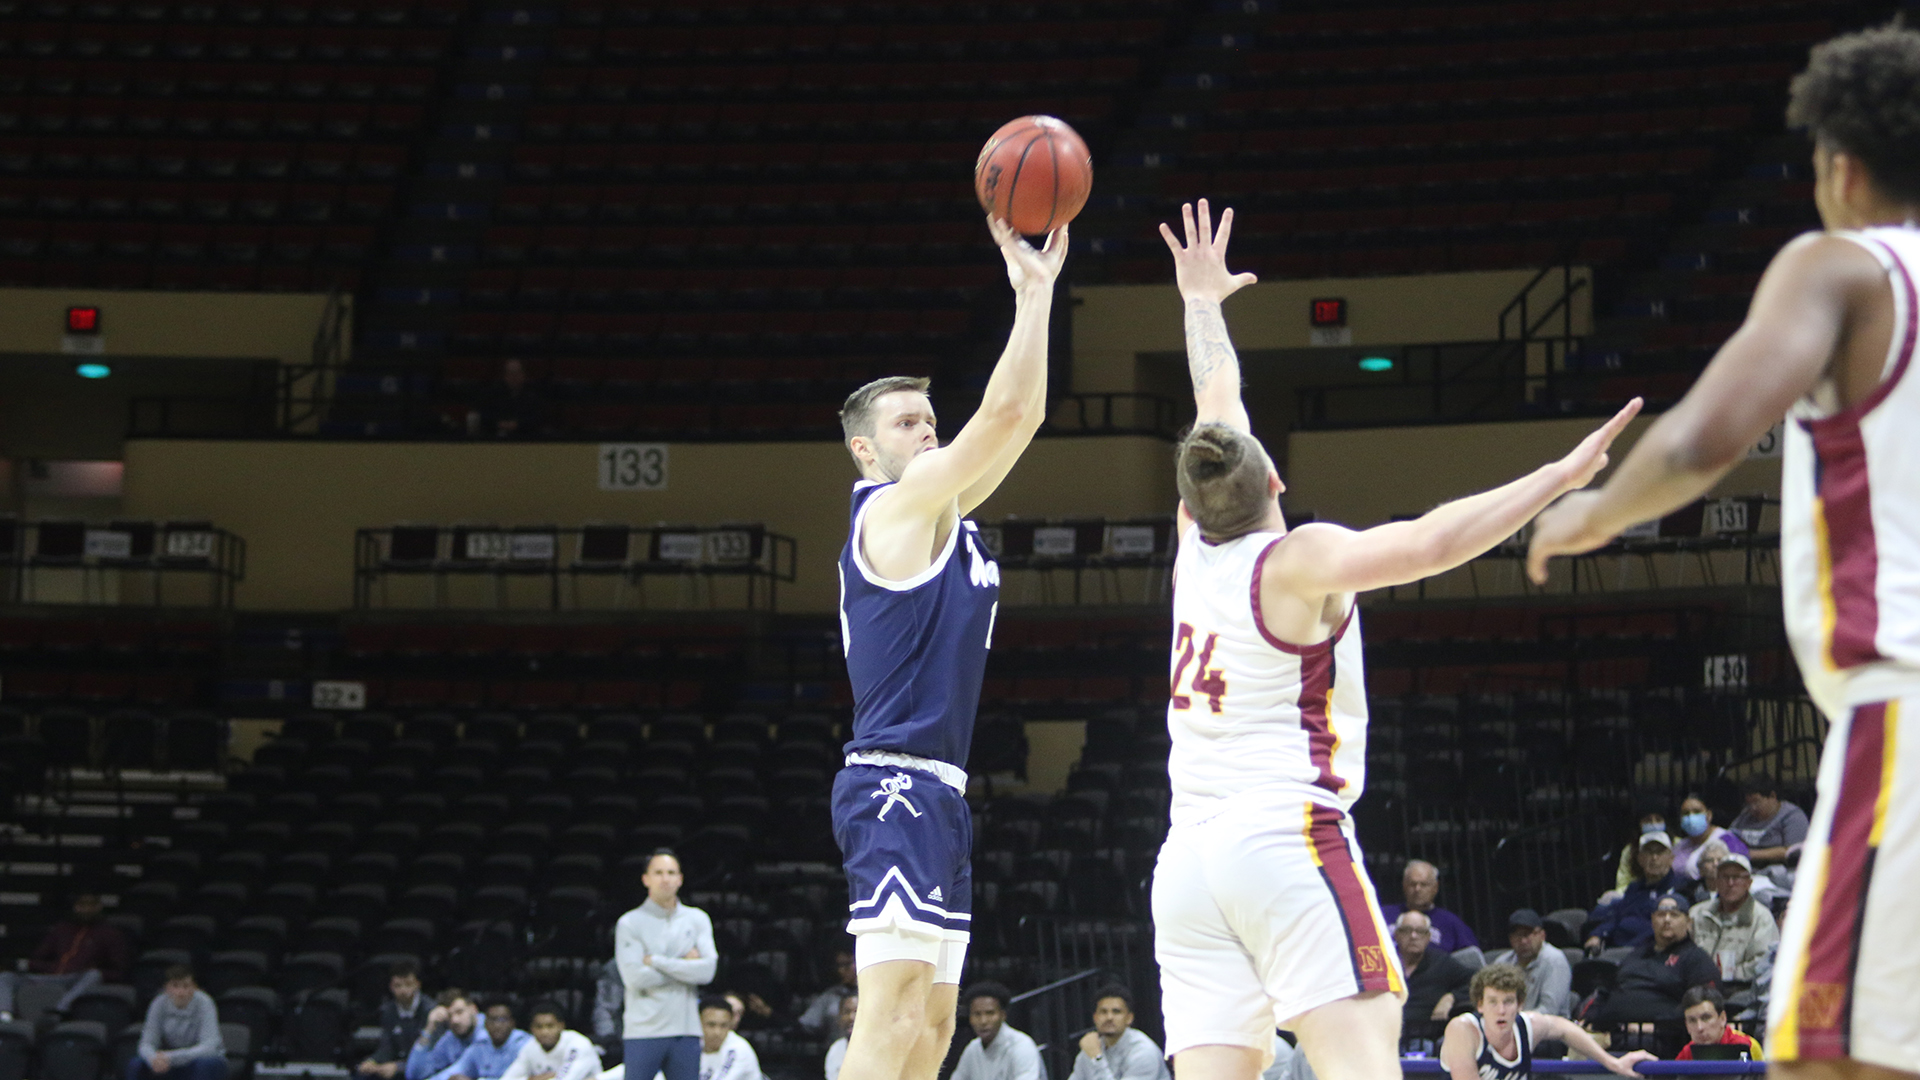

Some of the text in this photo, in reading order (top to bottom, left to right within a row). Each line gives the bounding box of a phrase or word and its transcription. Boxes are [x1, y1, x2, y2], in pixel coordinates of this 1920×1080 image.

[1738, 208, 1749, 224] K
[604, 447, 663, 487] 133
[1714, 507, 1744, 529] 131
[1171, 621, 1227, 715] 24
[1357, 945, 1384, 972] N
